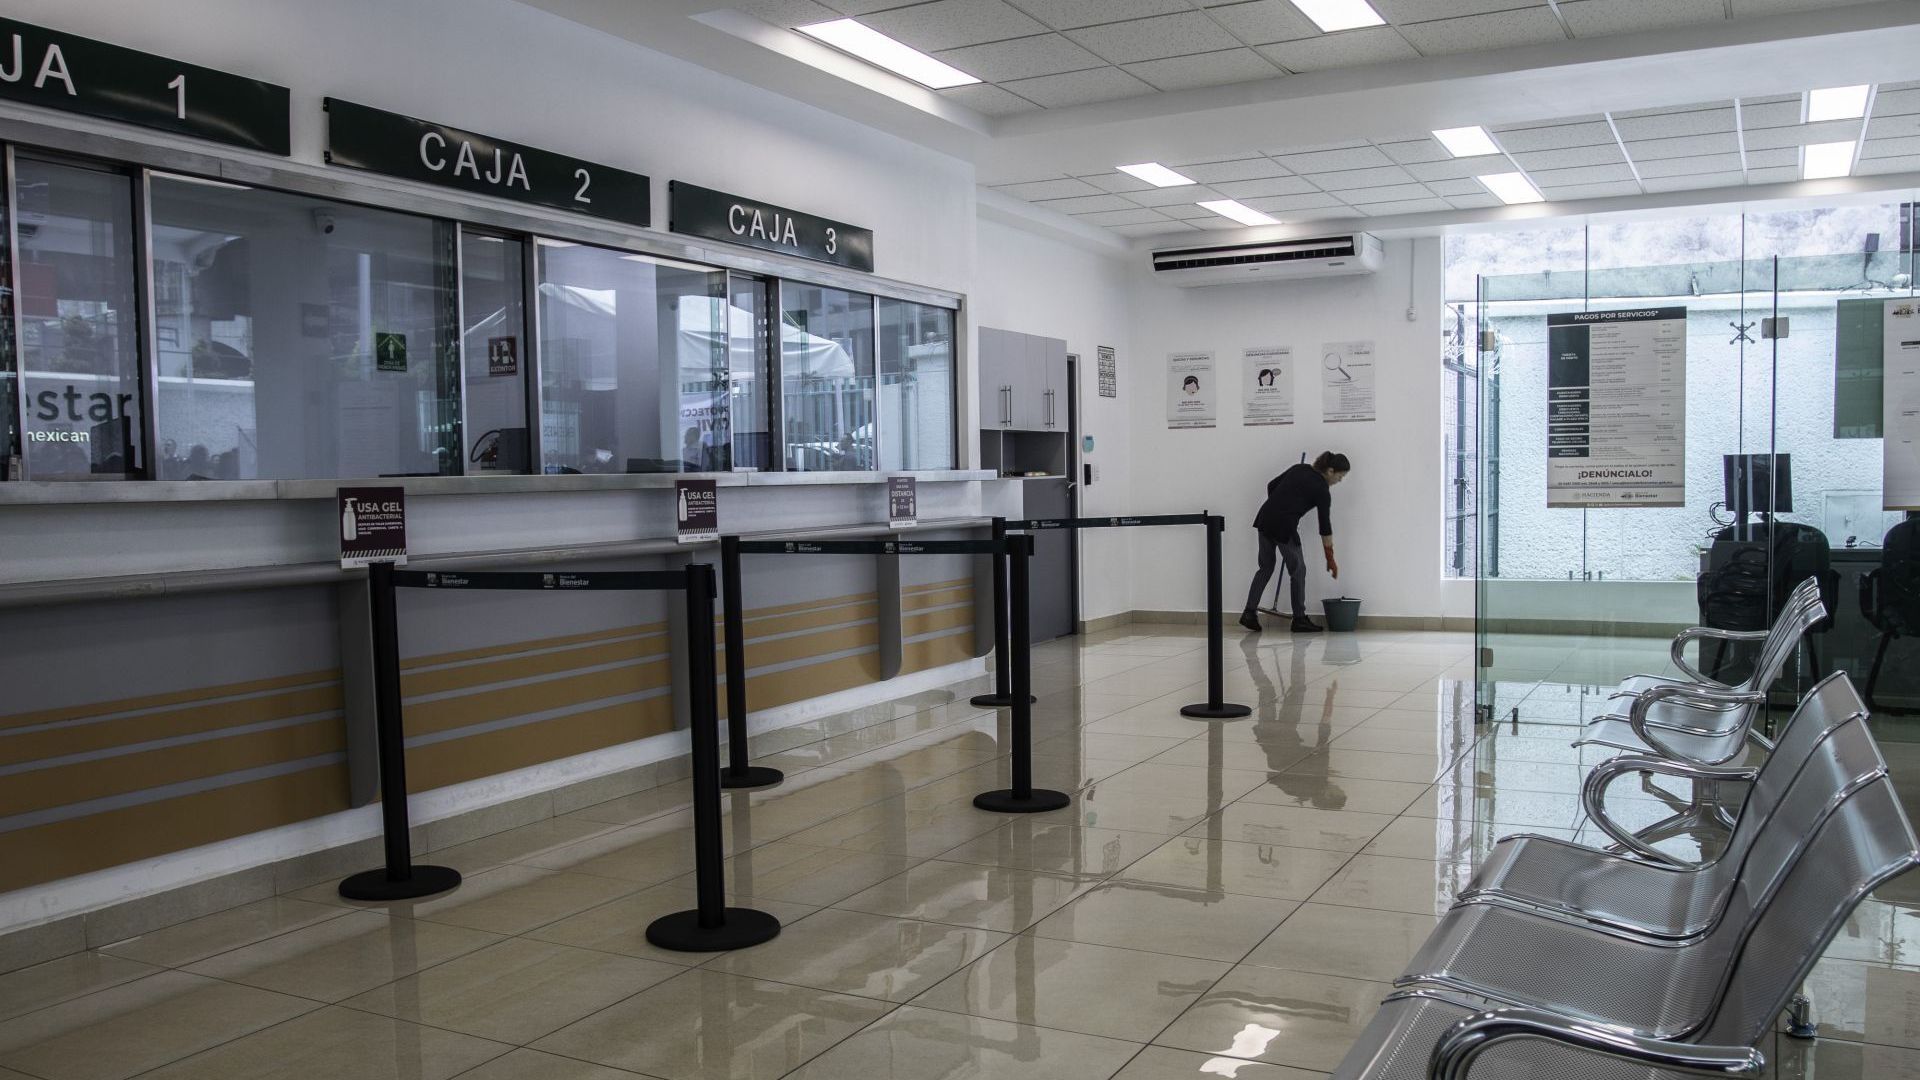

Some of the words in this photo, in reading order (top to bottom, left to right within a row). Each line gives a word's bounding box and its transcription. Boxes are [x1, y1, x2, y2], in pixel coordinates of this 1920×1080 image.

[167, 74, 186, 120] 1
[419, 131, 531, 191] CAJA
[574, 168, 591, 204] 2
[728, 204, 798, 247] CAJA
[825, 227, 837, 255] 3
[1574, 313, 1599, 321] PAGOS
[1600, 312, 1616, 320] POR
[1578, 469, 1653, 480] ¡DENÚNCIALO!
[688, 491, 701, 500] USA
[702, 491, 715, 500] GEL
[357, 502, 379, 513] USA
[382, 502, 402, 512] GEL
[358, 513, 402, 521] ANTIBACTERIAL
[559, 578, 590, 586] Bienestar
